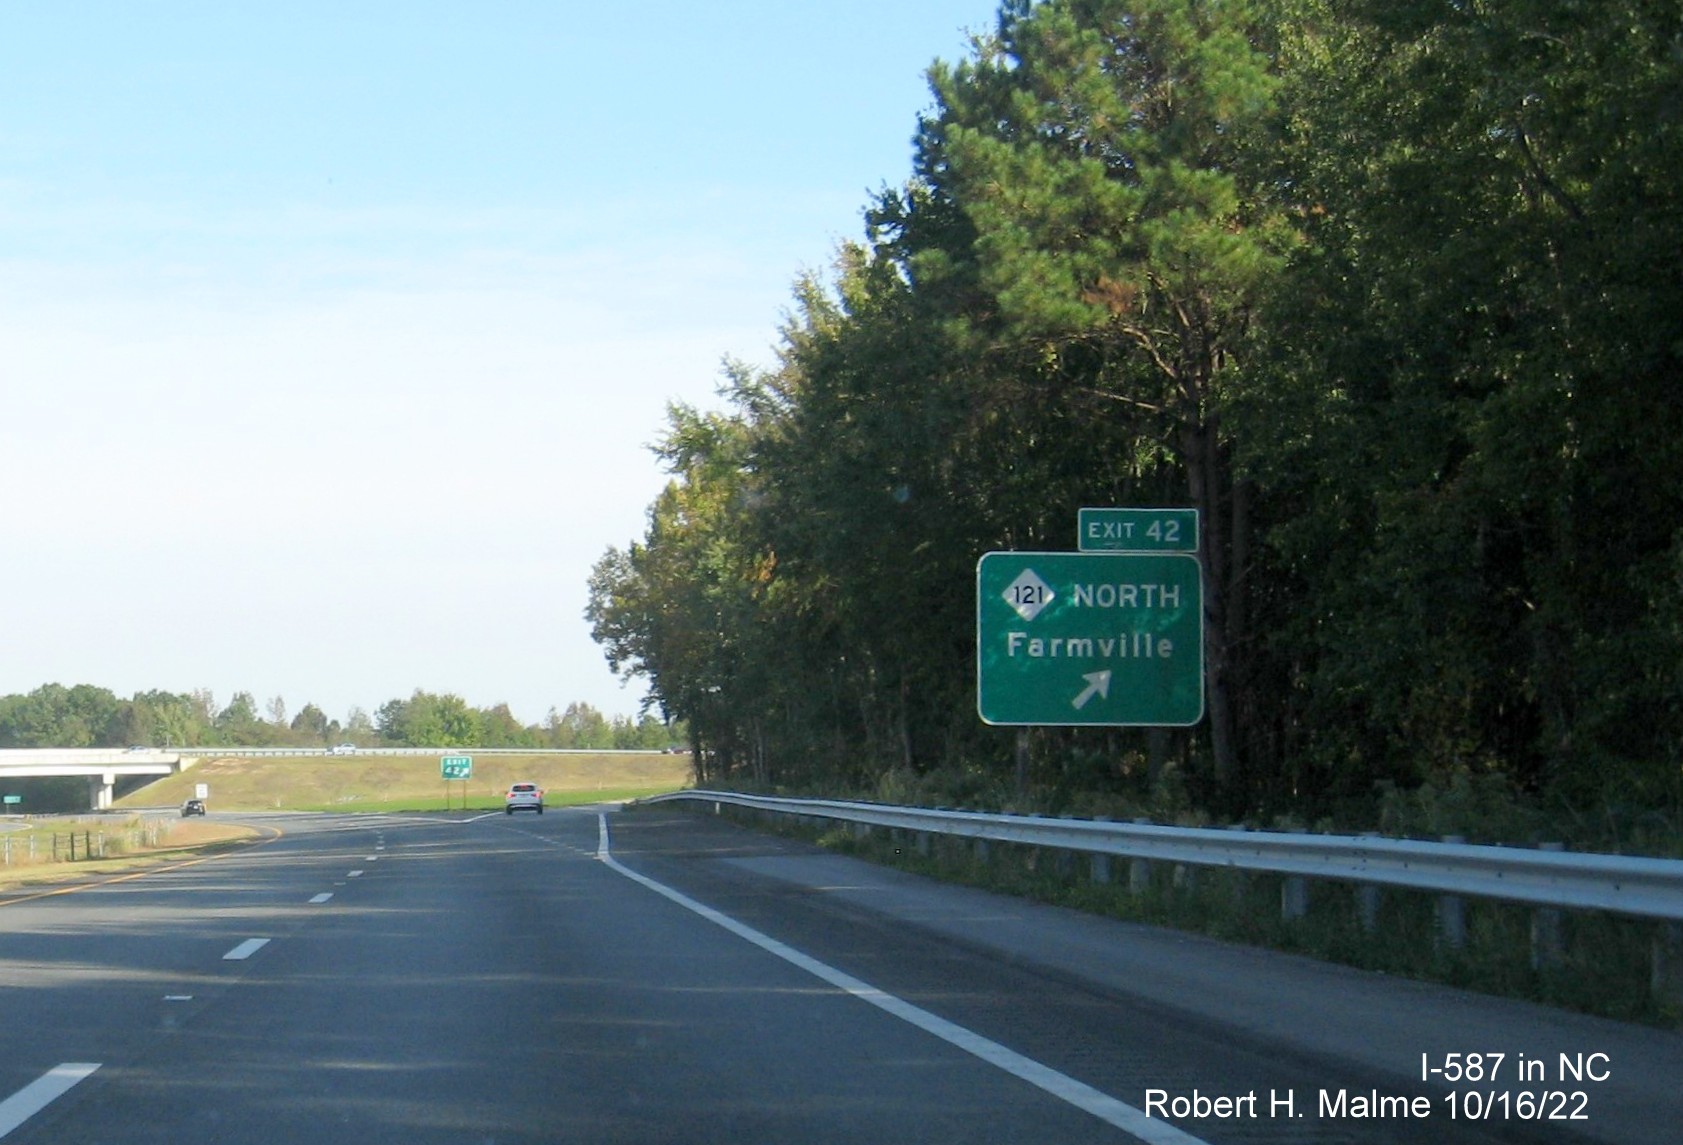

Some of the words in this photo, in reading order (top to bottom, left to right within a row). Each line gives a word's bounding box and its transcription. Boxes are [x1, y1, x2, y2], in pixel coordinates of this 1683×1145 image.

[1088, 522, 1135, 539] EXIT
[1145, 521, 1181, 541] 42
[1013, 586, 1044, 604] 121
[1074, 584, 1180, 608] NORTH
[1007, 632, 1173, 658] Farmville
[444, 766, 460, 775] 42
